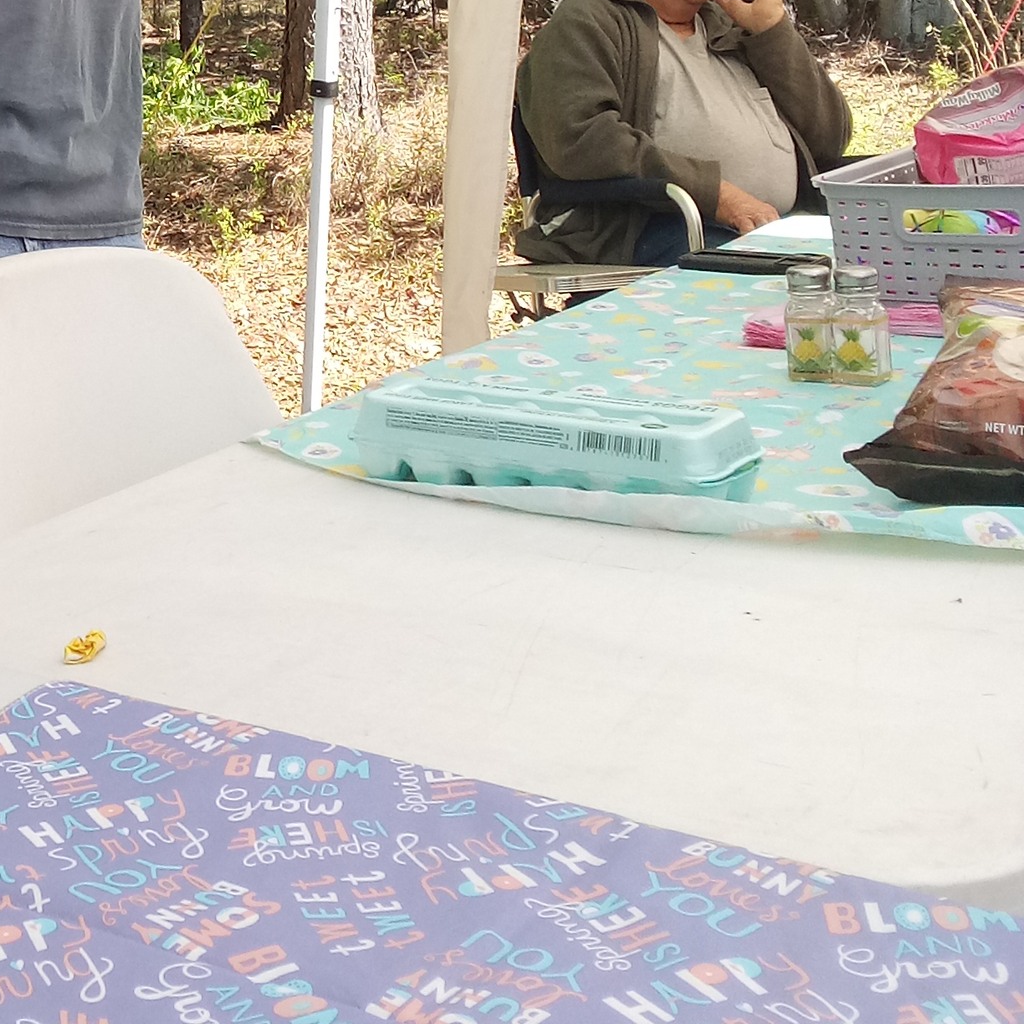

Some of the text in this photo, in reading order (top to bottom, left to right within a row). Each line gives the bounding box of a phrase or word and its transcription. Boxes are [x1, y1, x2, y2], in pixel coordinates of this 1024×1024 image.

[985, 422, 1006, 434] NET
[142, 712, 240, 756] BUNNY
[91, 739, 176, 784] YOU
[223, 754, 370, 782] BLOOM
[215, 784, 344, 822] Grow
[262, 783, 339, 799] AND
[18, 788, 186, 848] HAPPY
[68, 859, 183, 903] YOU
[420, 841, 607, 905] HAPPY
[681, 841, 828, 904] BUNNY
[131, 880, 250, 945] BUNNY
[640, 870, 763, 938] YOU
[823, 902, 1021, 935] BLOOM
[162, 892, 282, 962] SOME
[895, 935, 992, 958] AND
[460, 929, 585, 993] YOU
[837, 944, 1009, 994] Grow
